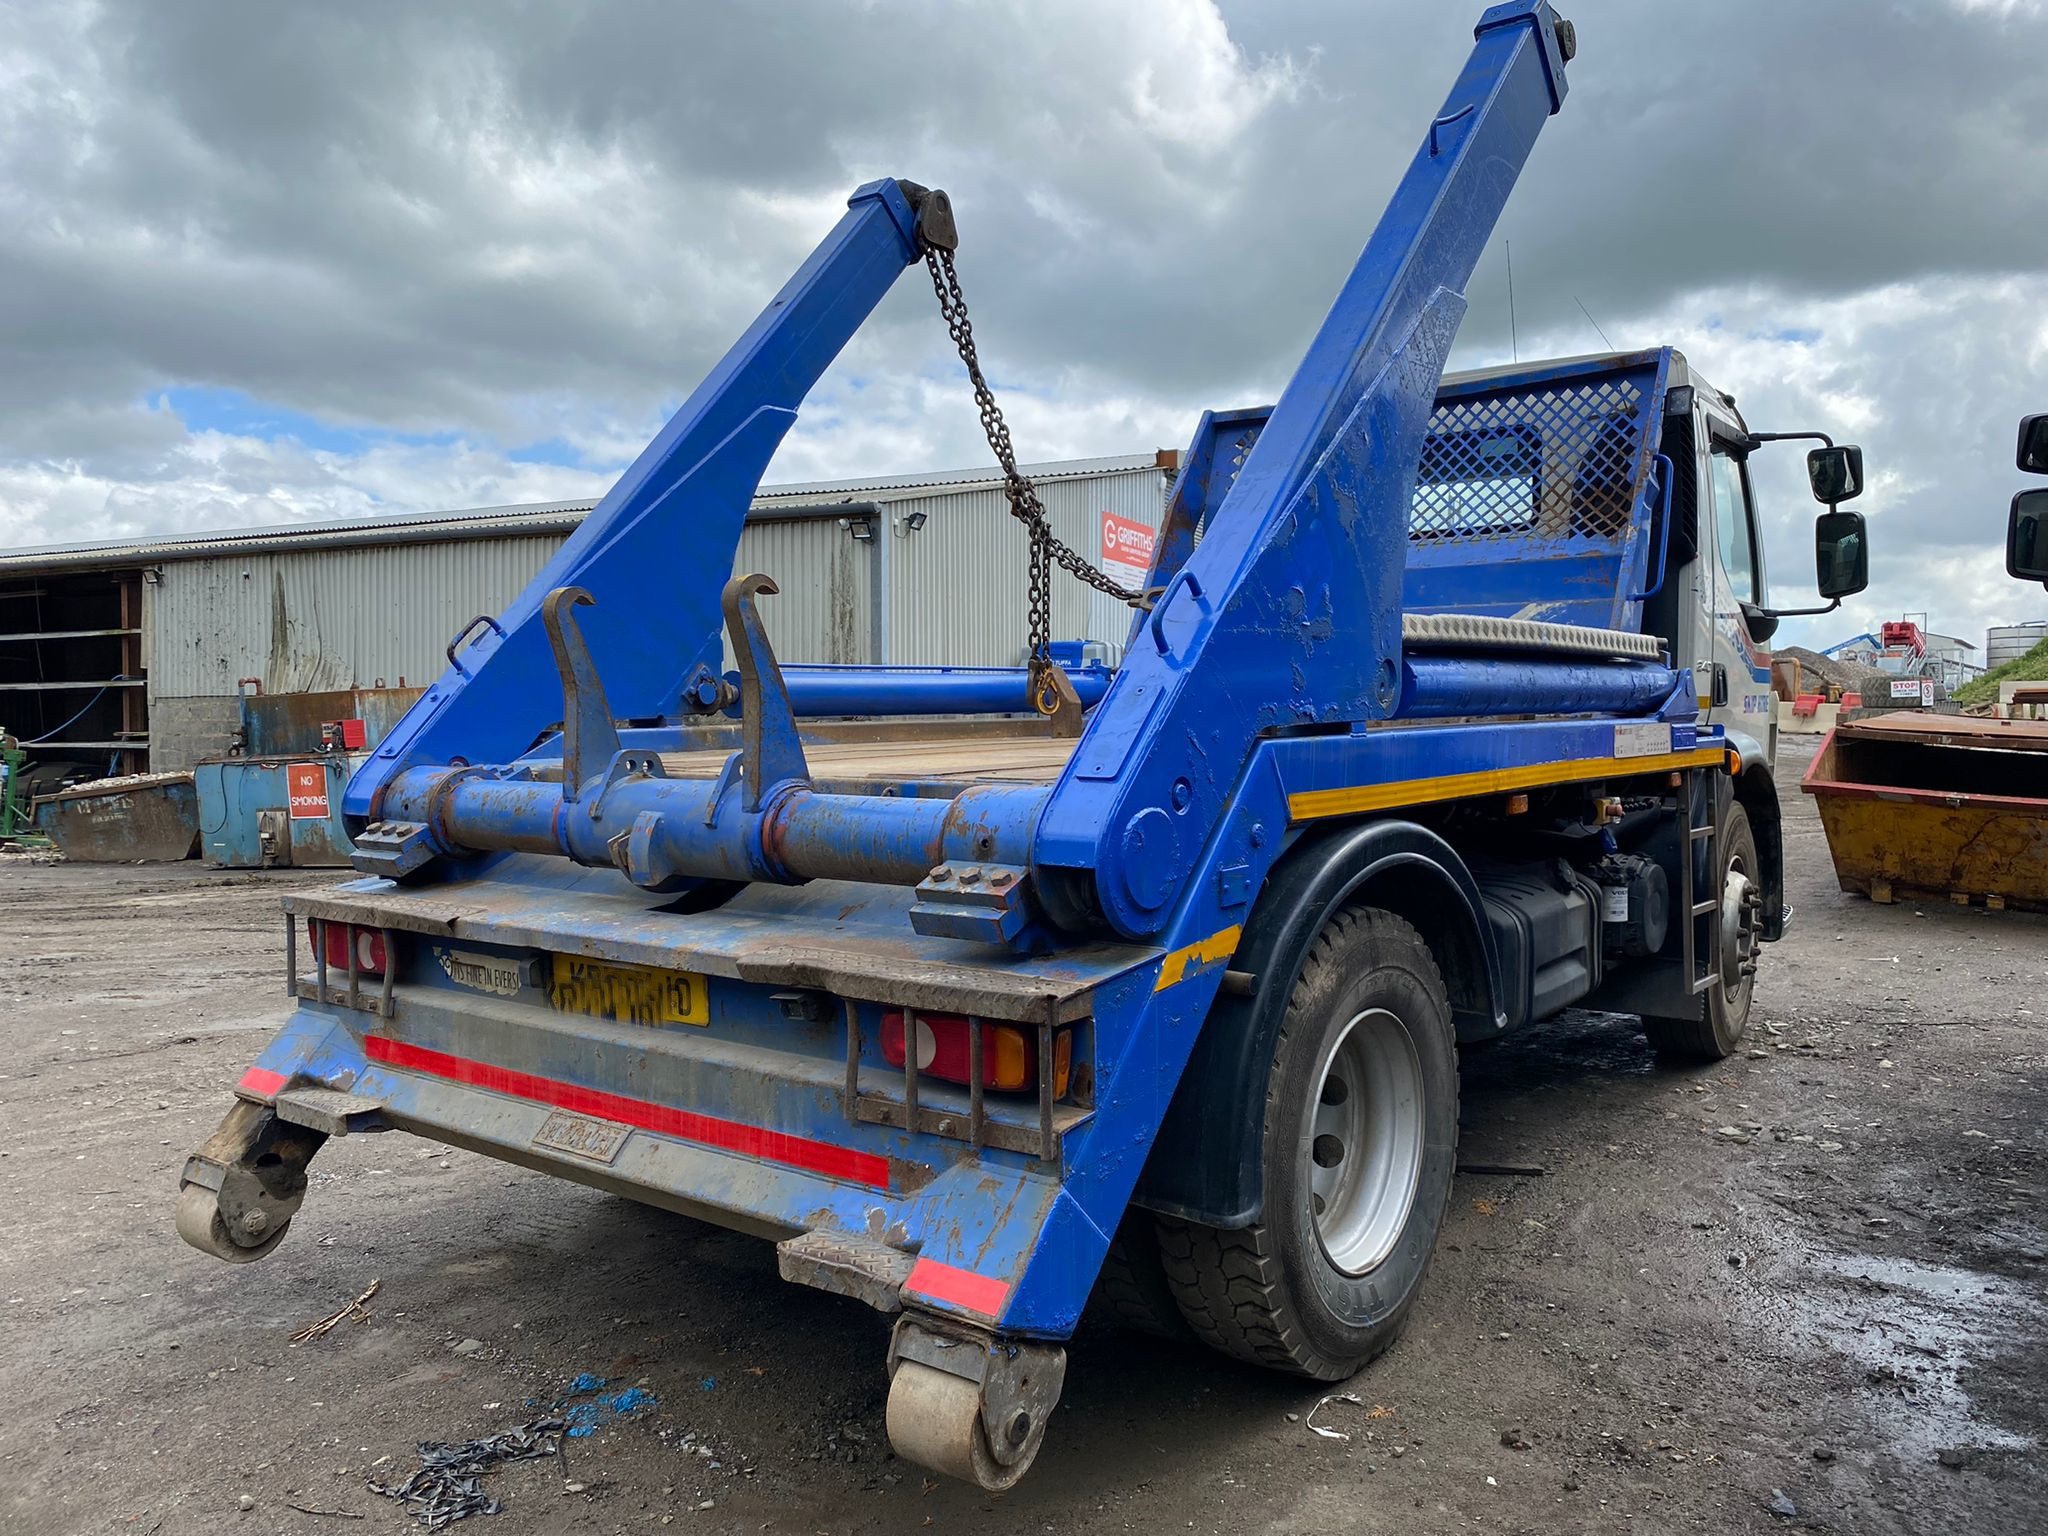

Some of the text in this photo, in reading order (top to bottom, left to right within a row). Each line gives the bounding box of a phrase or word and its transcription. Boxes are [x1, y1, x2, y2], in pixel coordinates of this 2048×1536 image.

[1104, 519, 1116, 548] G
[1117, 526, 1153, 552] GRIFFITHS
[300, 775, 313, 786] NO
[291, 795, 327, 807] SMOKING
